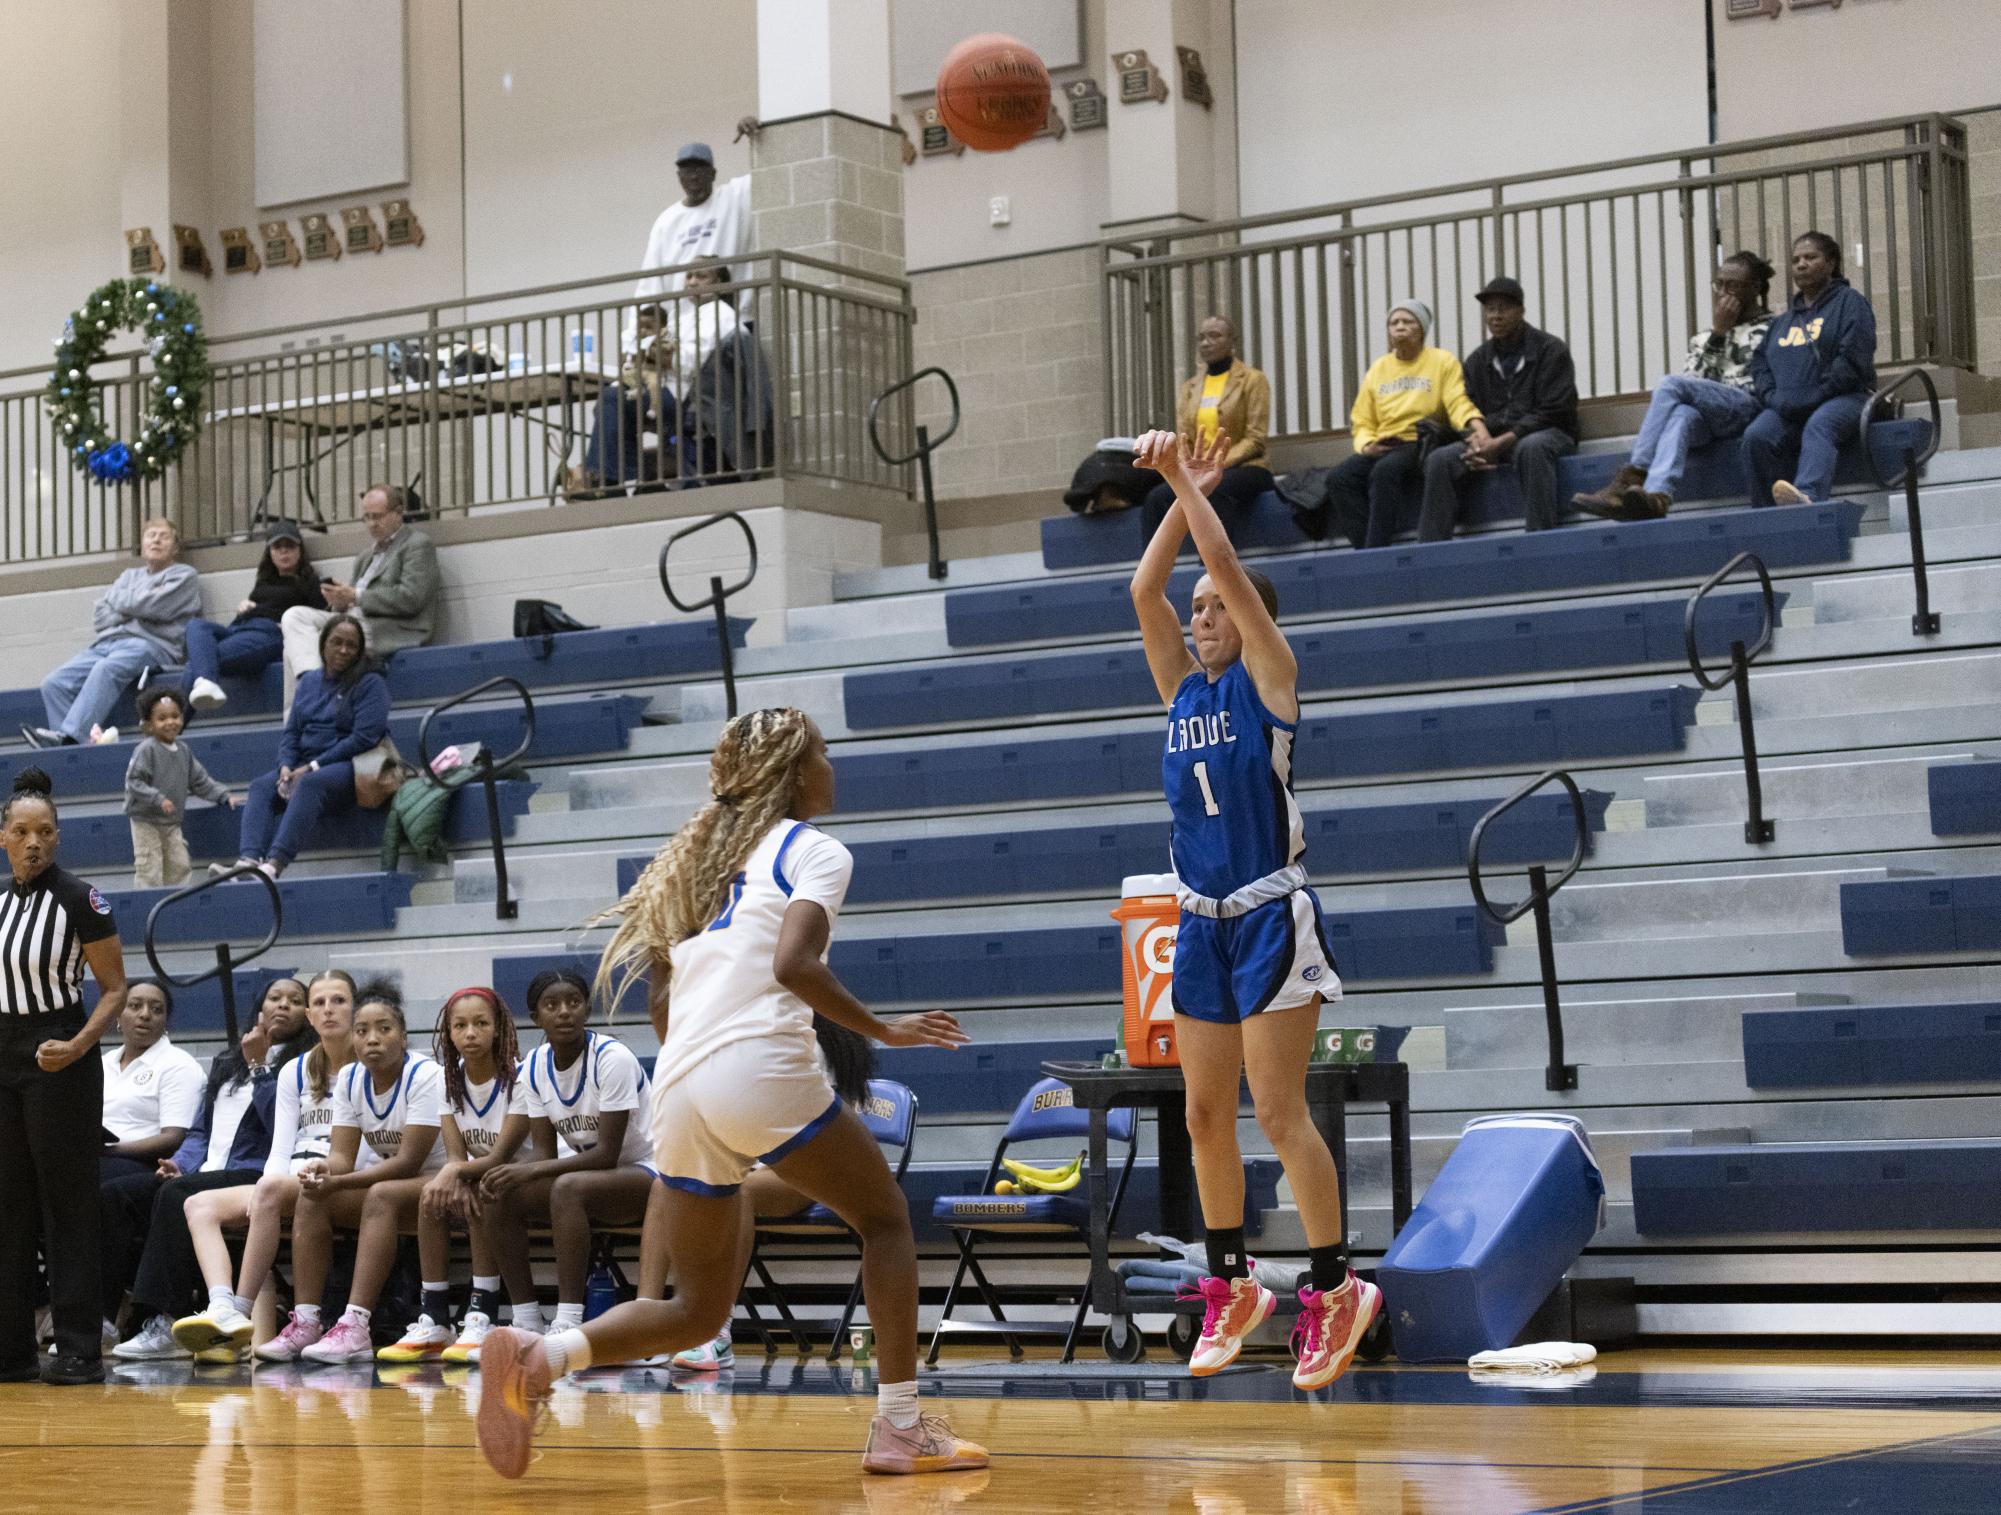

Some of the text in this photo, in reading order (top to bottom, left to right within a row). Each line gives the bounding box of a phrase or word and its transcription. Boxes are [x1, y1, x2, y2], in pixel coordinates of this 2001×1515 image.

[1168, 710, 1237, 753] LADUE
[1193, 761, 1220, 816] 1
[1143, 925, 1181, 973] G
[1326, 1033, 1342, 1052] G
[556, 1114, 600, 1136] RROUG
[954, 1202, 1027, 1215] BOMBERS
[850, 1331, 864, 1350] G
